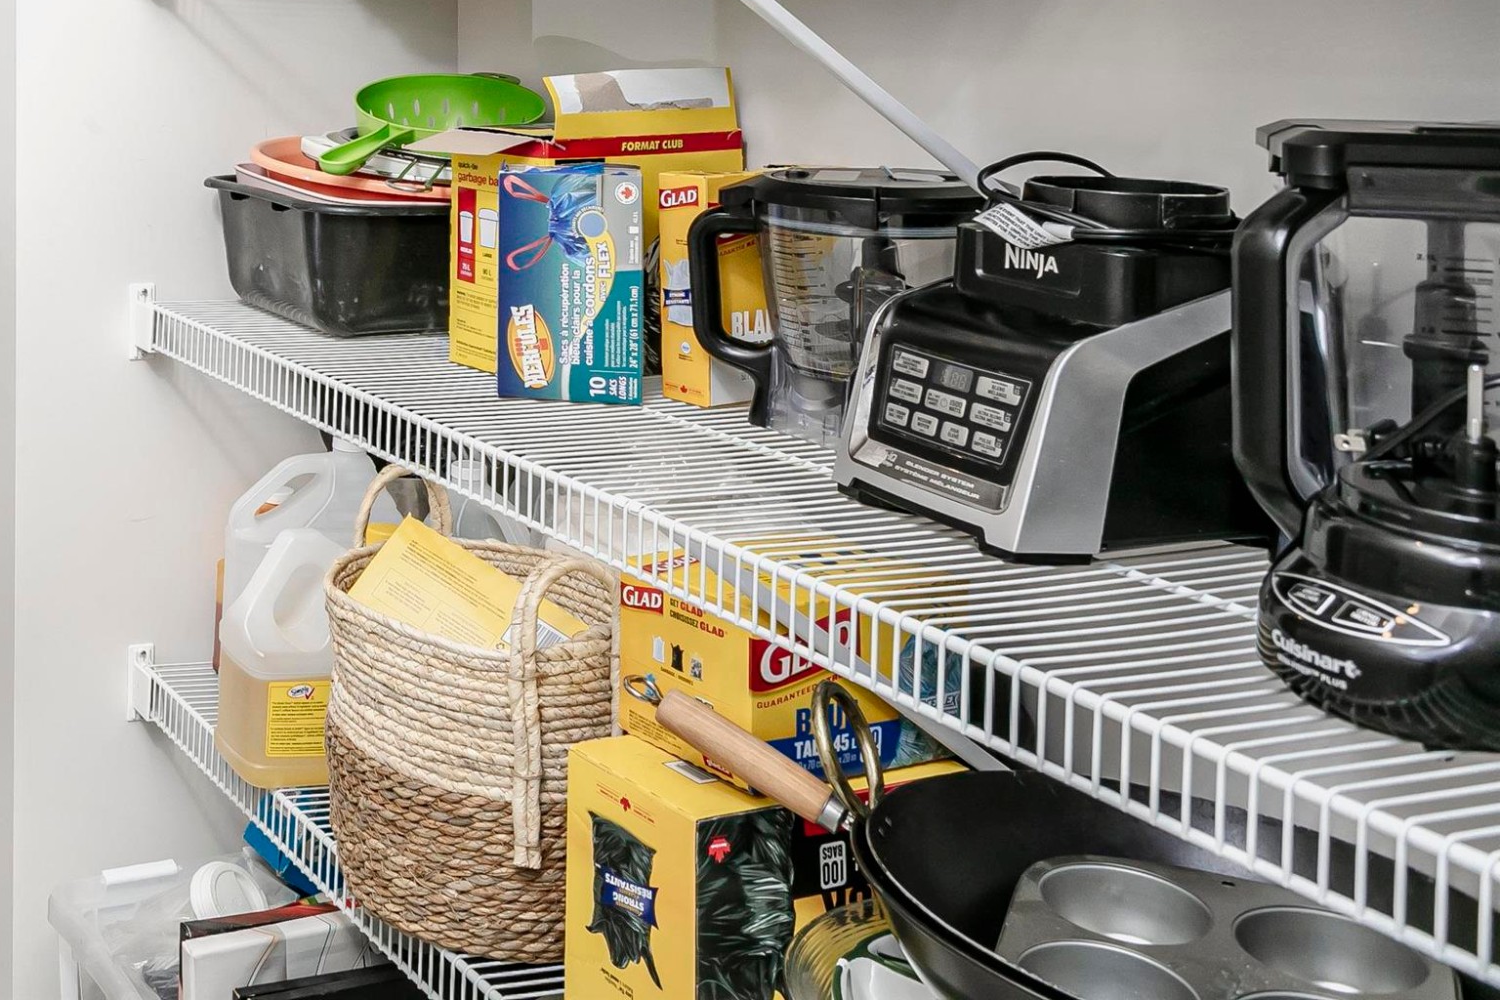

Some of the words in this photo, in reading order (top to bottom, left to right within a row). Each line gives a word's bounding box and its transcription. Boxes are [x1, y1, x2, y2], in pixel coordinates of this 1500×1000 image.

[621, 142, 660, 152] FORMAT
[662, 138, 684, 150] CLUB
[457, 172, 487, 186] garbage
[488, 175, 499, 187] ba
[659, 188, 698, 208] GLAD
[597, 241, 612, 279] FLEX
[1004, 242, 1060, 279] NINJA
[571, 269, 581, 280] la
[585, 256, 596, 318] cordons
[559, 263, 571, 328] récupération
[571, 282, 583, 306] pour
[599, 280, 607, 302] avec
[559, 329, 569, 338] à
[571, 307, 581, 336] clairs
[584, 319, 594, 328] à
[730, 309, 773, 341] BLA
[510, 304, 549, 389] HERCULES
[559, 340, 570, 365] Sacs
[570, 337, 581, 366] bleus
[585, 329, 594, 366] cuisine
[589, 376, 607, 398] 10
[609, 378, 618, 396] SACS
[618, 375, 627, 400] LONGS
[905, 460, 940, 477] BLENDER
[940, 473, 975, 489] SYSTEM
[622, 585, 663, 610] GLAD
[669, 597, 679, 608] GET
[679, 600, 704, 618] GLAD
[699, 621, 725, 639] GLAD
[1271, 628, 1360, 680] Cuisinart
[1320, 673, 1348, 690] PLUS
[756, 682, 819, 710] GUARANTEED
[794, 741, 822, 760] TAL
[833, 733, 850, 752] 45
[850, 737, 858, 750] L
[822, 844, 843, 860] BAGS
[822, 859, 844, 886] 100
[604, 872, 653, 900] RÉSISTANTS
[612, 891, 645, 911] STRONG
